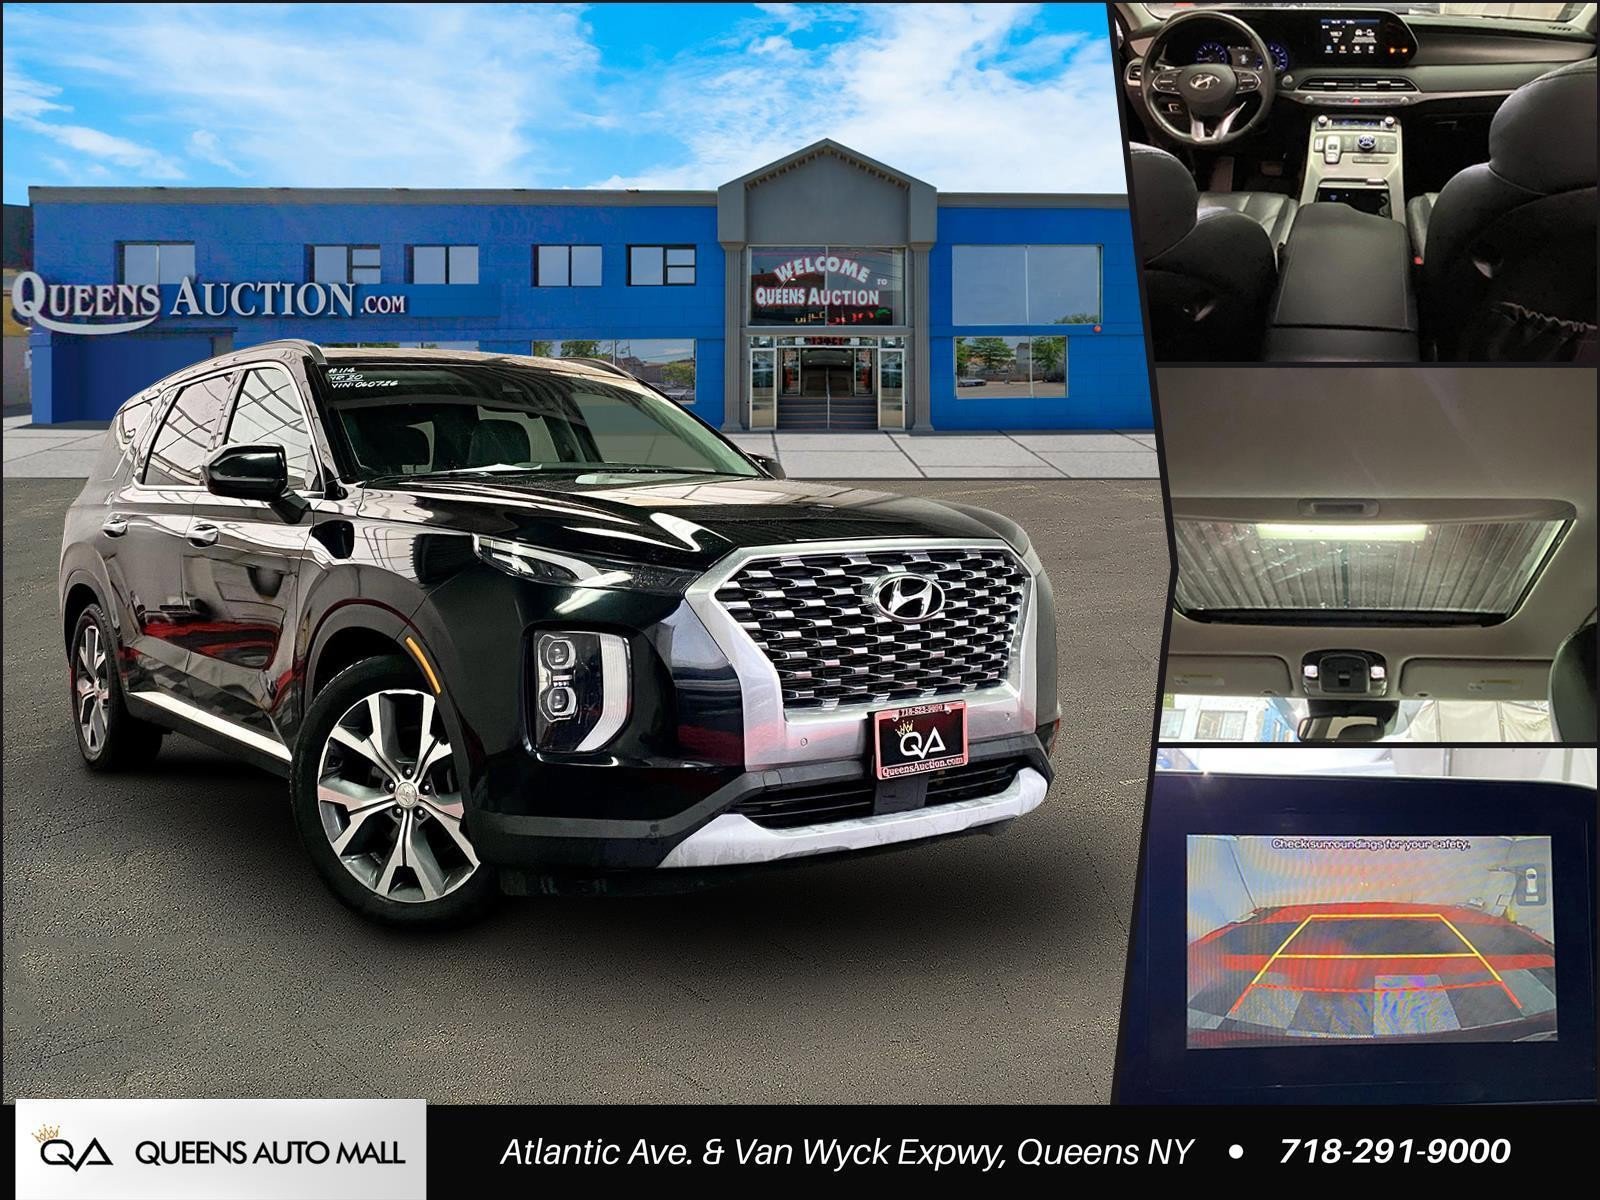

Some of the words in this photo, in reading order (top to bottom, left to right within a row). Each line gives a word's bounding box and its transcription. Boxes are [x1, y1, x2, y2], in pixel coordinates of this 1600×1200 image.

[773, 256, 871, 283] WELCOME
[12, 271, 161, 335] QUEENS
[170, 276, 356, 317] AUCTION
[755, 287, 806, 307] QUEENS
[808, 287, 880, 306] AUCTION
[900, 726, 946, 759] QA
[882, 757, 963, 776] QueensAuction.com
[1272, 838, 1309, 849] Check
[1309, 838, 1383, 851] surroundings
[1385, 838, 1402, 849] for
[1403, 840, 1431, 851] your
